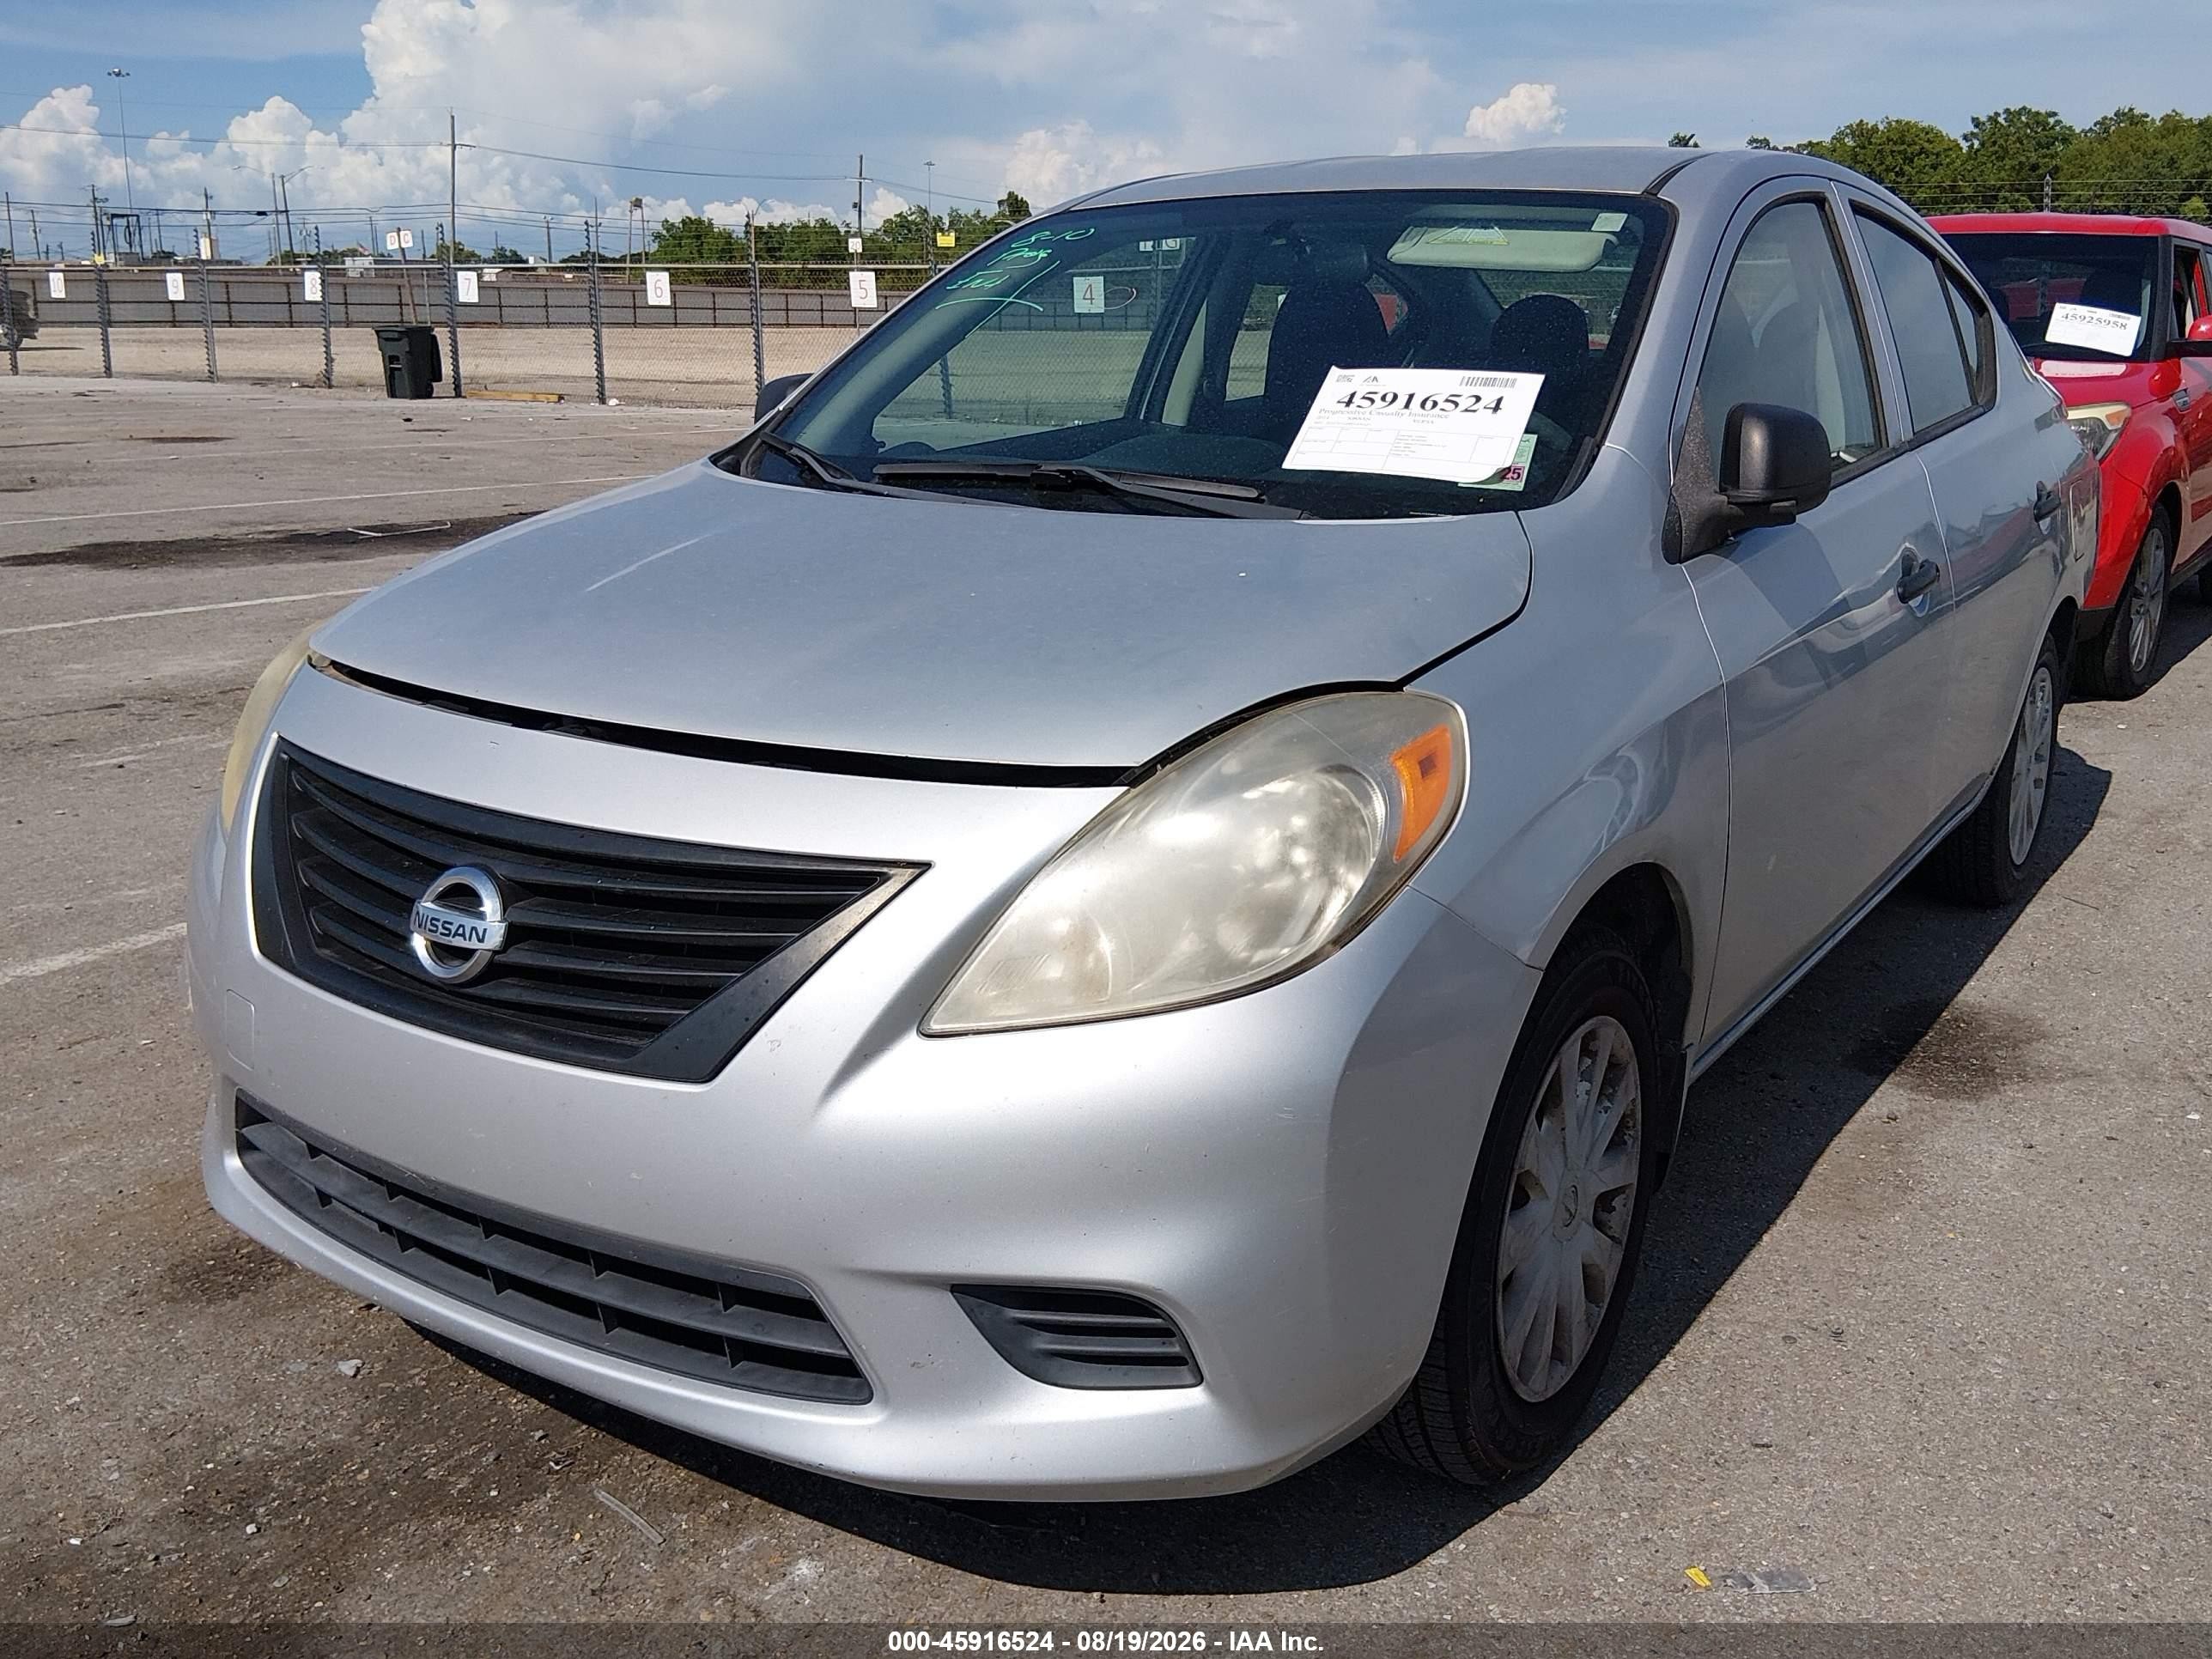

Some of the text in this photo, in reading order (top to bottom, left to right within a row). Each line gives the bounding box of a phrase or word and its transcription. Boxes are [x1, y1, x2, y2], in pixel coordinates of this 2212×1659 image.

[389, 234, 396, 245] D
[403, 233, 410, 243] C
[849, 240, 861, 250] 20
[51, 276, 64, 293] 10
[171, 279, 179, 295] 9
[309, 278, 319, 295] 8
[463, 278, 471, 296] 7
[653, 279, 663, 299] 6
[859, 279, 868, 300] 5
[1083, 283, 1095, 305] 4
[2061, 313, 2128, 330] 45925958
[1336, 391, 1504, 414] 45916524
[1502, 467, 1522, 481] 25
[413, 911, 489, 944] NISSAN
